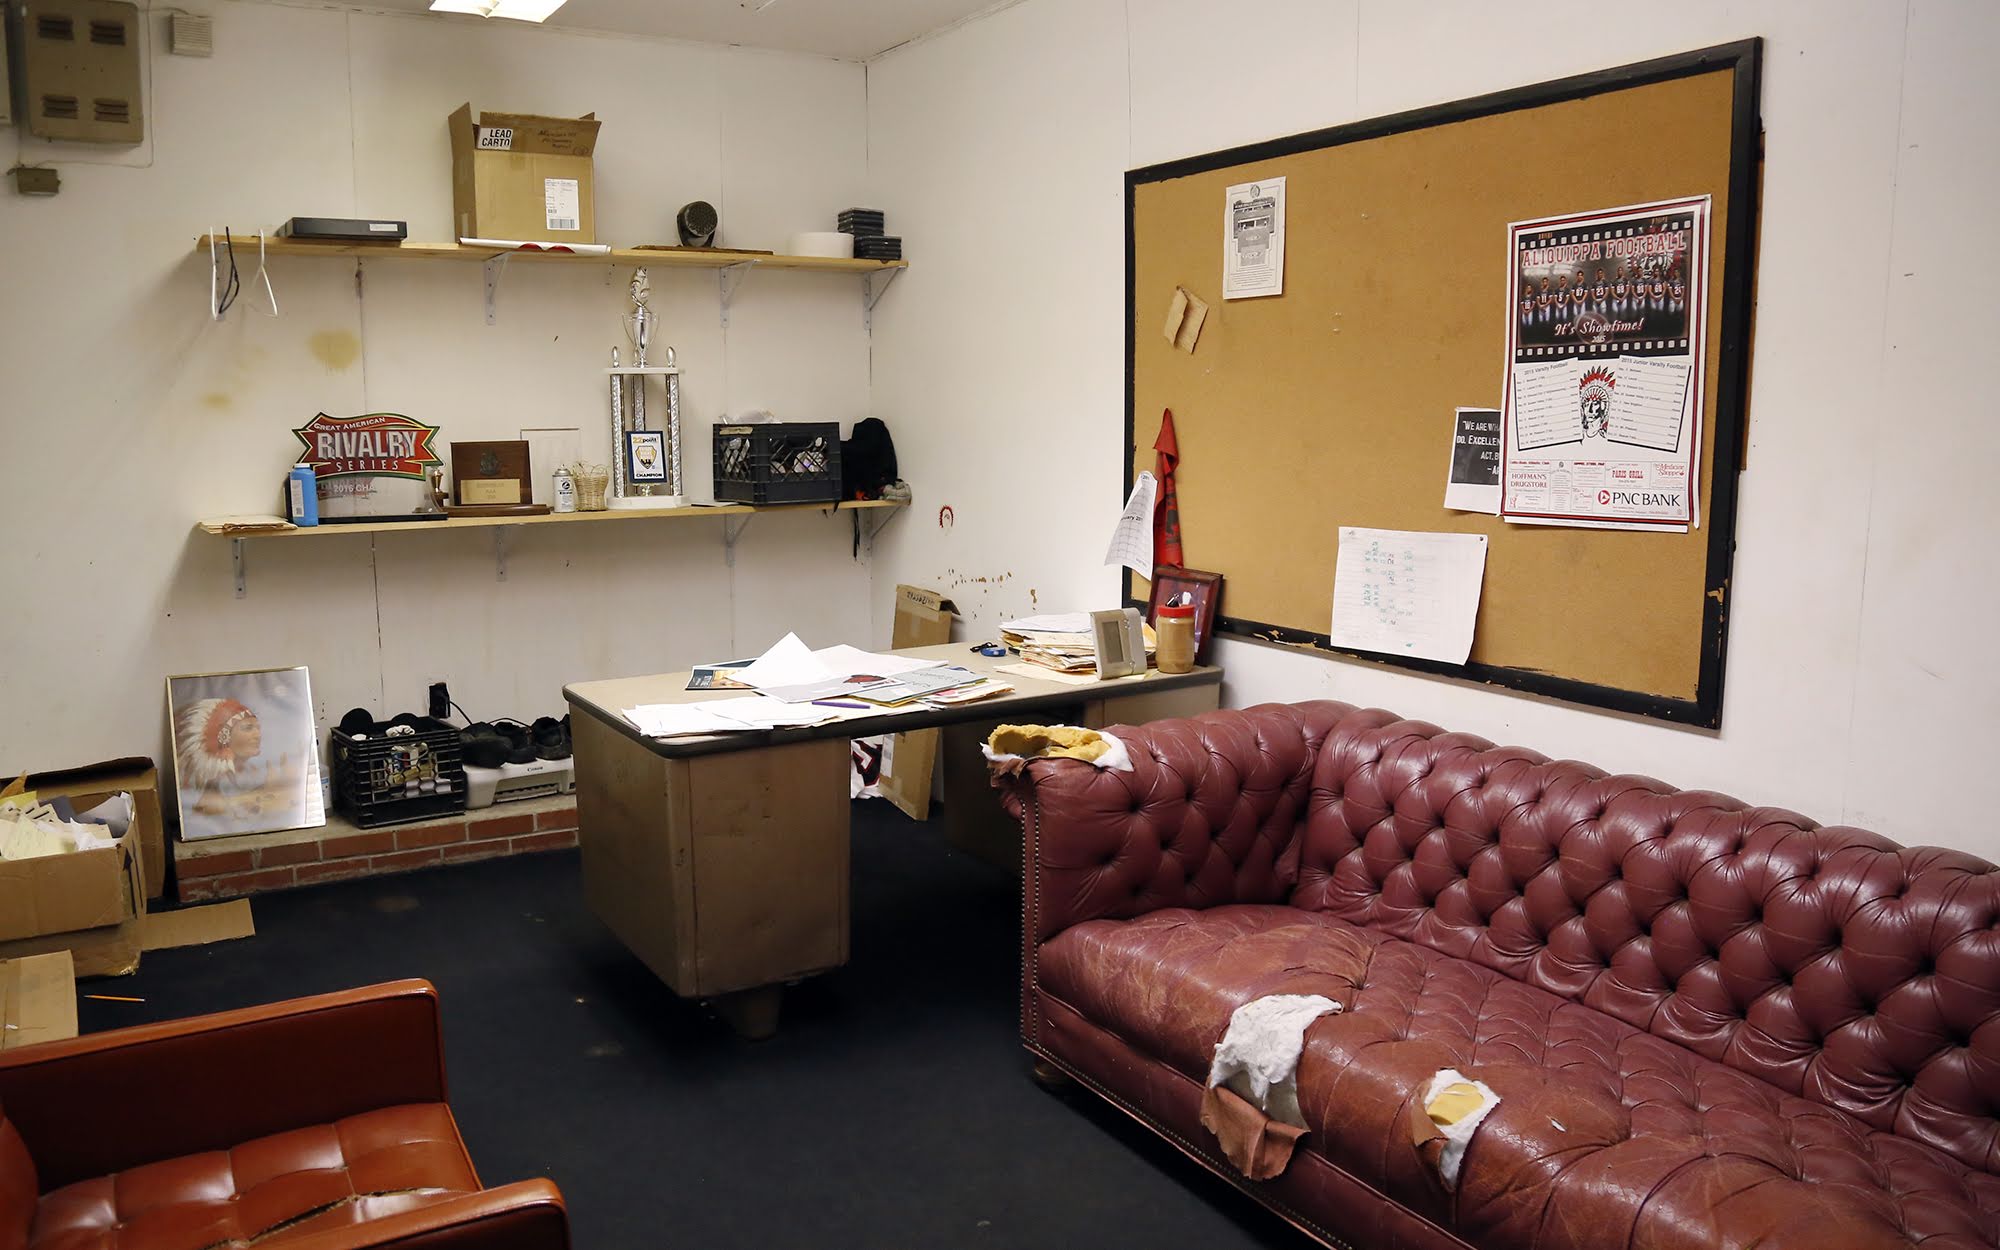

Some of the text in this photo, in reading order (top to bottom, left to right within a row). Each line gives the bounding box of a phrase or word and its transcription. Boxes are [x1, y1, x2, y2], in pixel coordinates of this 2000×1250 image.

[490, 129, 512, 138] LEAD
[1523, 230, 1686, 267] ALIQUIPPA FOOTBALL
[1555, 317, 1645, 336] It's Showtime!
[1550, 361, 1568, 370] Football
[314, 417, 386, 431] GREAT AMERICAN
[1475, 422, 1488, 432] ARE
[317, 431, 418, 459] RIVALRY
[1480, 451, 1494, 461] ACT.
[336, 460, 399, 471] SERIES
[1612, 492, 1681, 507] PNC BANK
